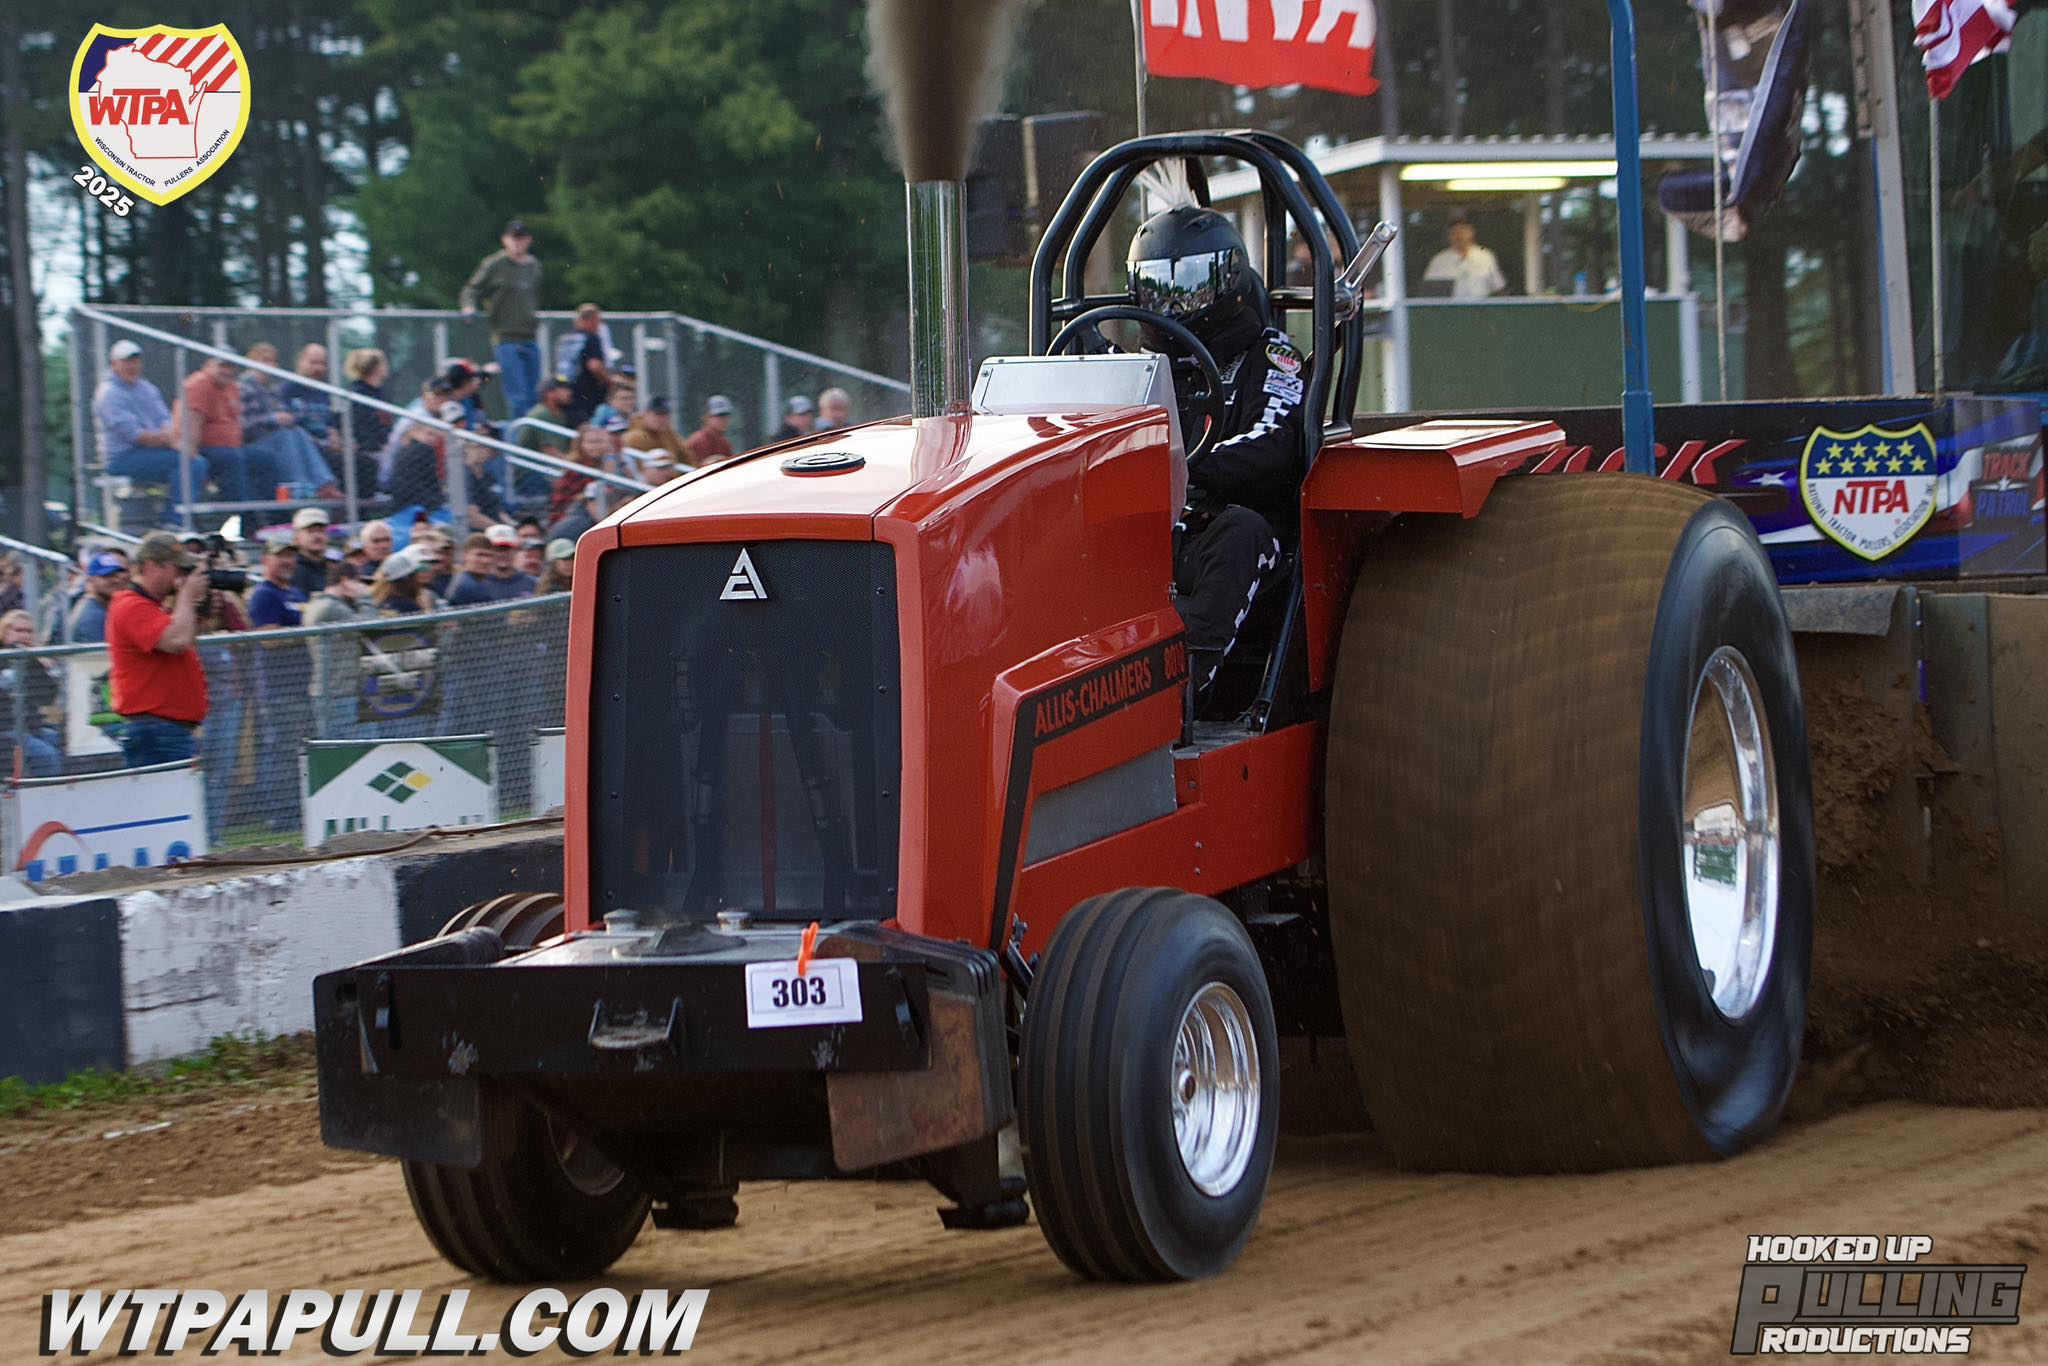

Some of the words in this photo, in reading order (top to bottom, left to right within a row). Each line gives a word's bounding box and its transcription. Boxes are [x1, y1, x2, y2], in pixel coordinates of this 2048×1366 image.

[1833, 479, 1910, 515] NTPA
[1034, 656, 1152, 738] ALLIS-CHALMERS
[772, 977, 827, 1008] 303
